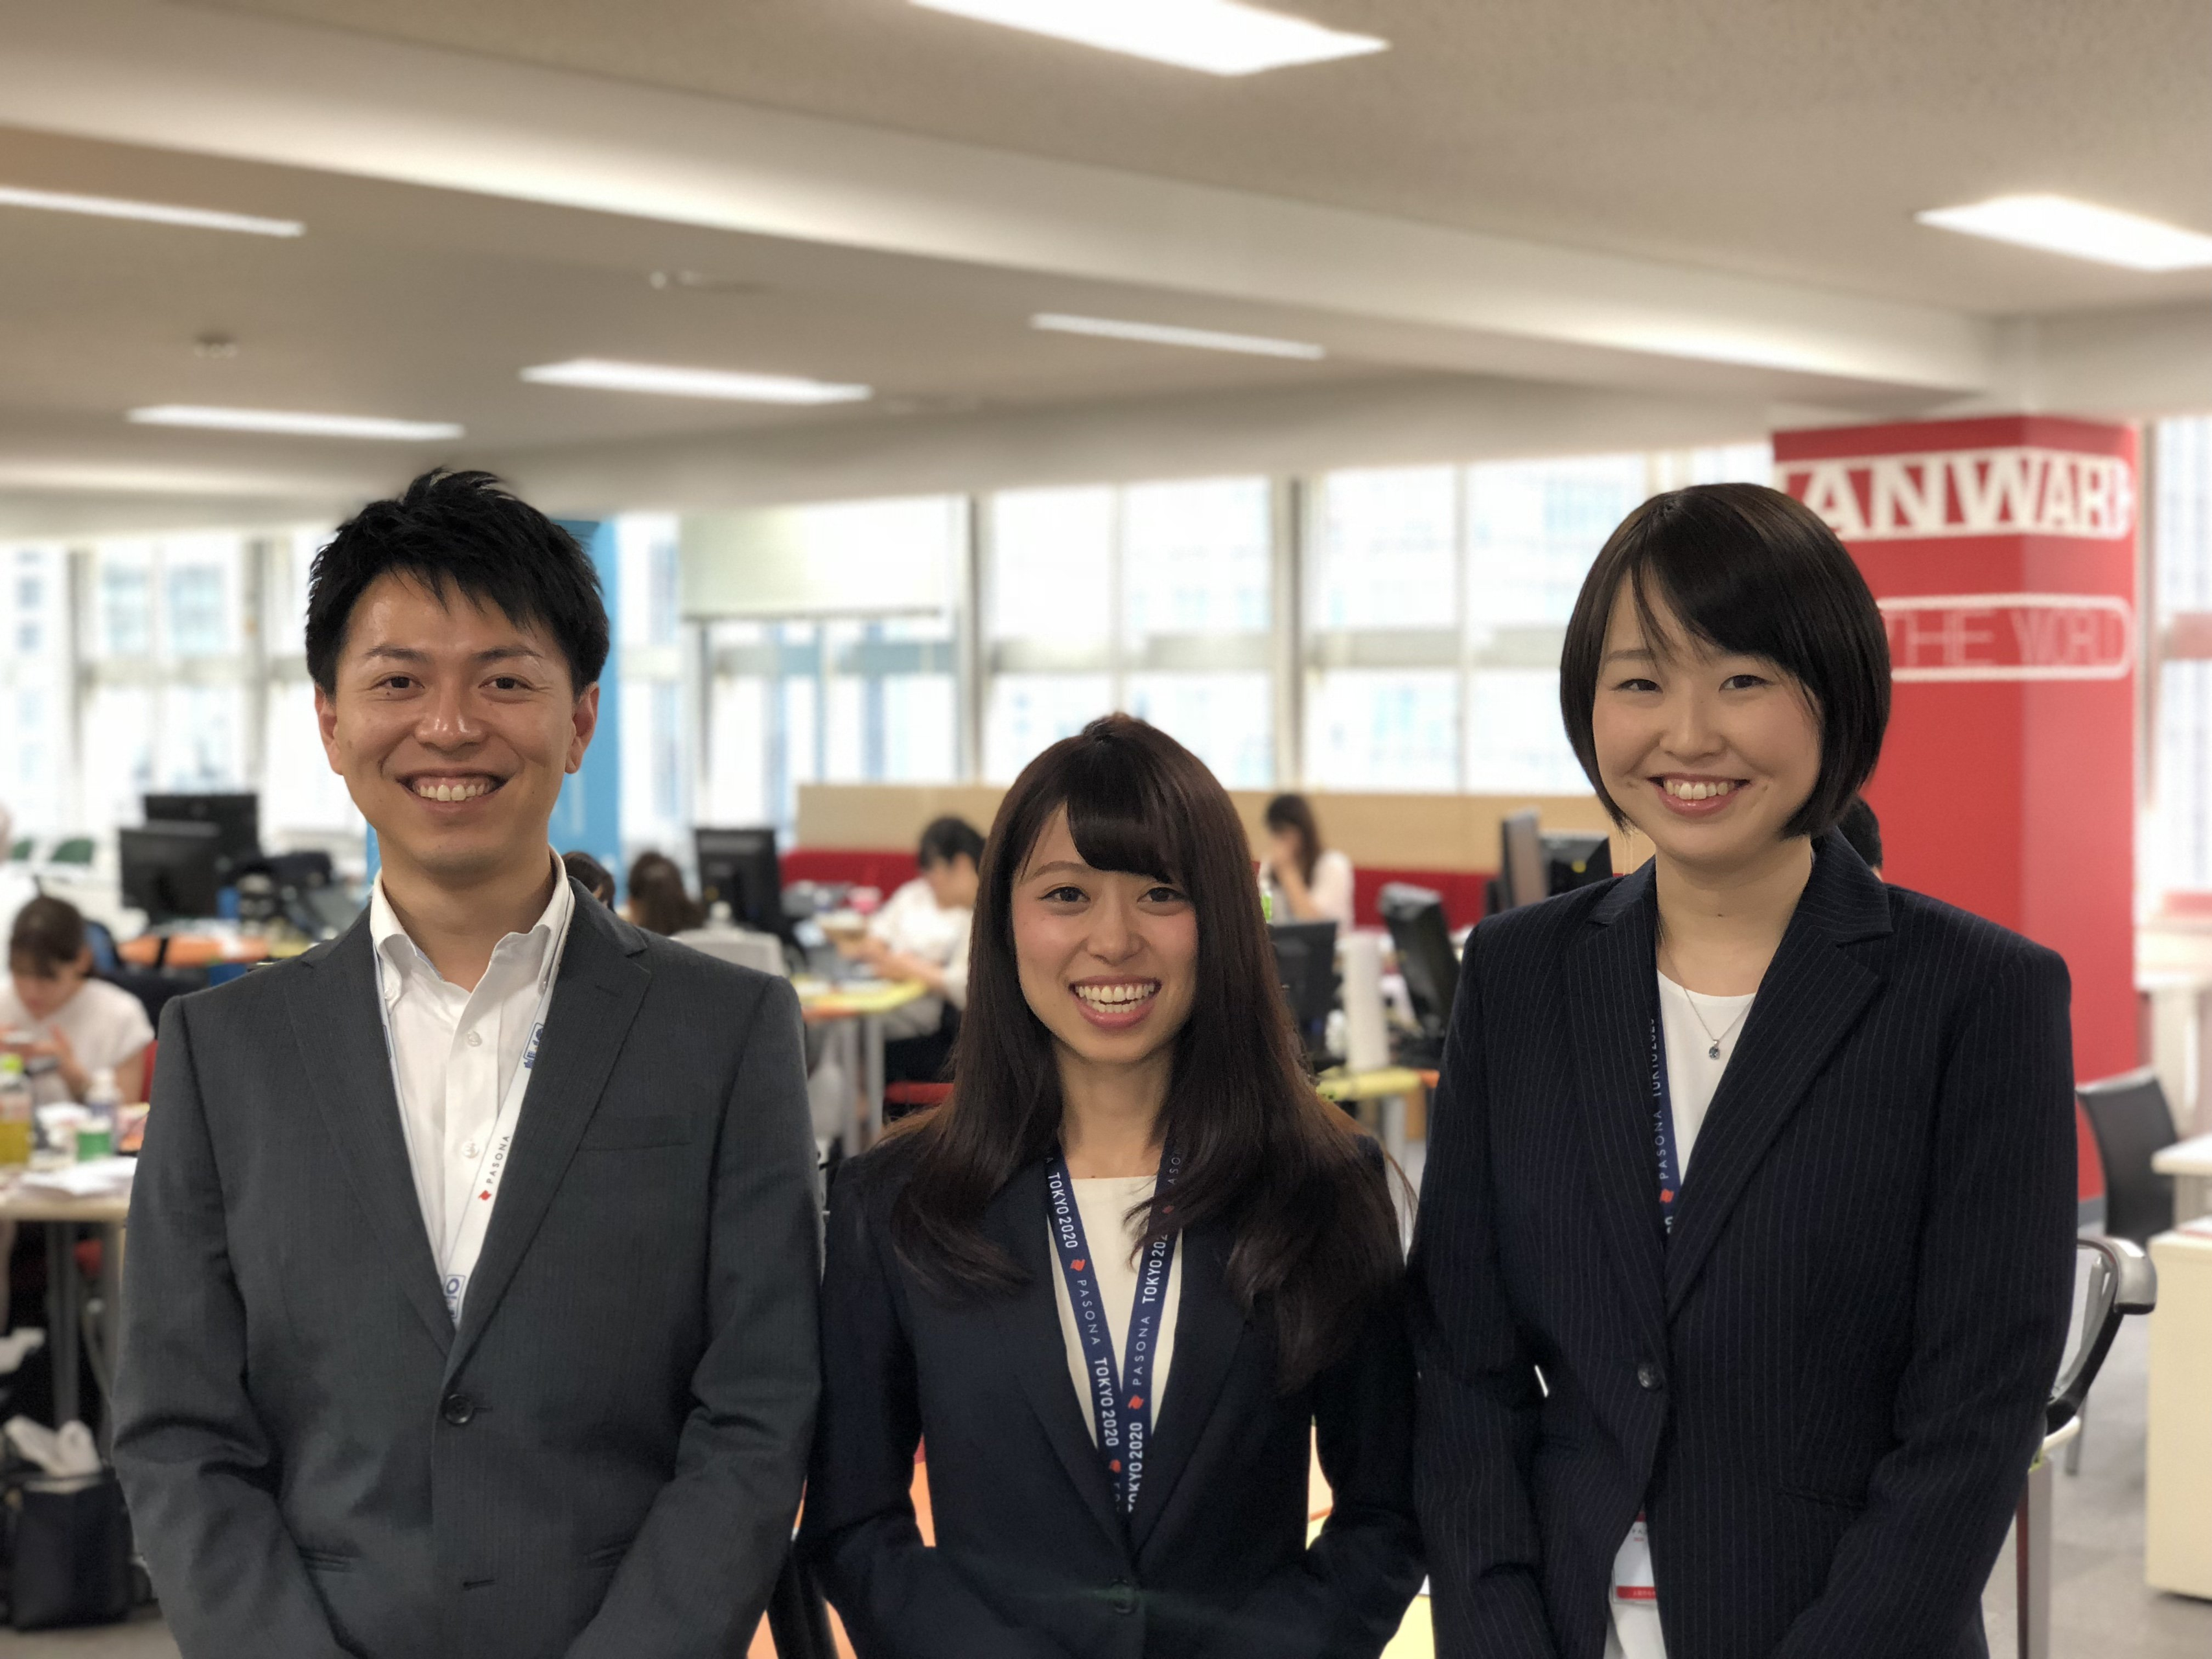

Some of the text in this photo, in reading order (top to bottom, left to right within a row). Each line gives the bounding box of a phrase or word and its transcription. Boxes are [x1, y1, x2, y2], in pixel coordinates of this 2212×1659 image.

[486, 1136, 509, 1184] PASONA
[1654, 1109, 1668, 1180] PASONA
[1047, 1172, 1069, 1215] TOKYO
[1058, 1216, 1078, 1249] 2020
[1077, 1279, 1101, 1345] PASONA
[1132, 1316, 1150, 1386] PASONA
[1142, 1260, 1162, 1304] TOKYO
[1094, 1357, 1114, 1407] TOKYO
[1102, 1410, 1119, 1447] 2020
[1129, 1422, 1143, 1458] 2020
